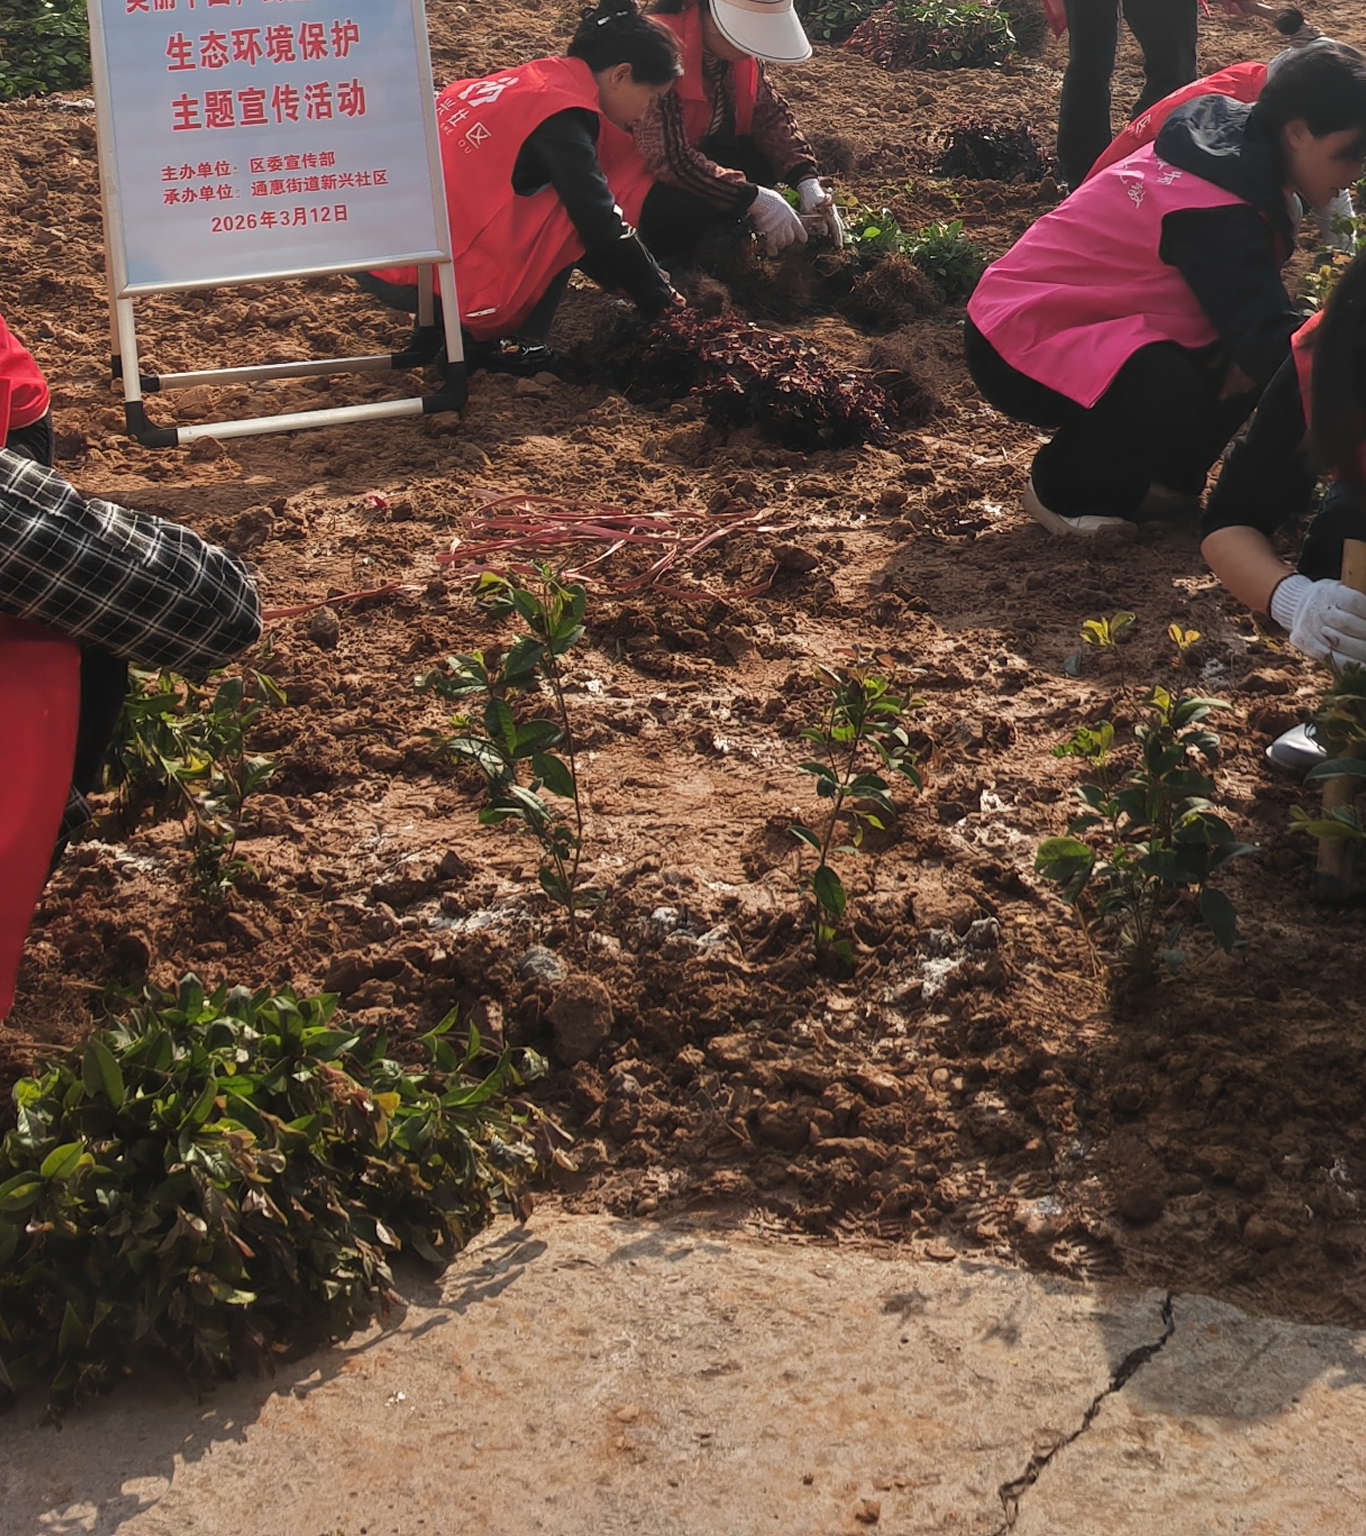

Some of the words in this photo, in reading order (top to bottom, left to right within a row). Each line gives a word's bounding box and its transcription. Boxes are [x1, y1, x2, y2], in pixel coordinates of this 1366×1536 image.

[165, 19, 360, 72] 生态环境保护
[171, 78, 367, 131] 主题宣传活动
[211, 204, 349, 233] 2026年3月12日
